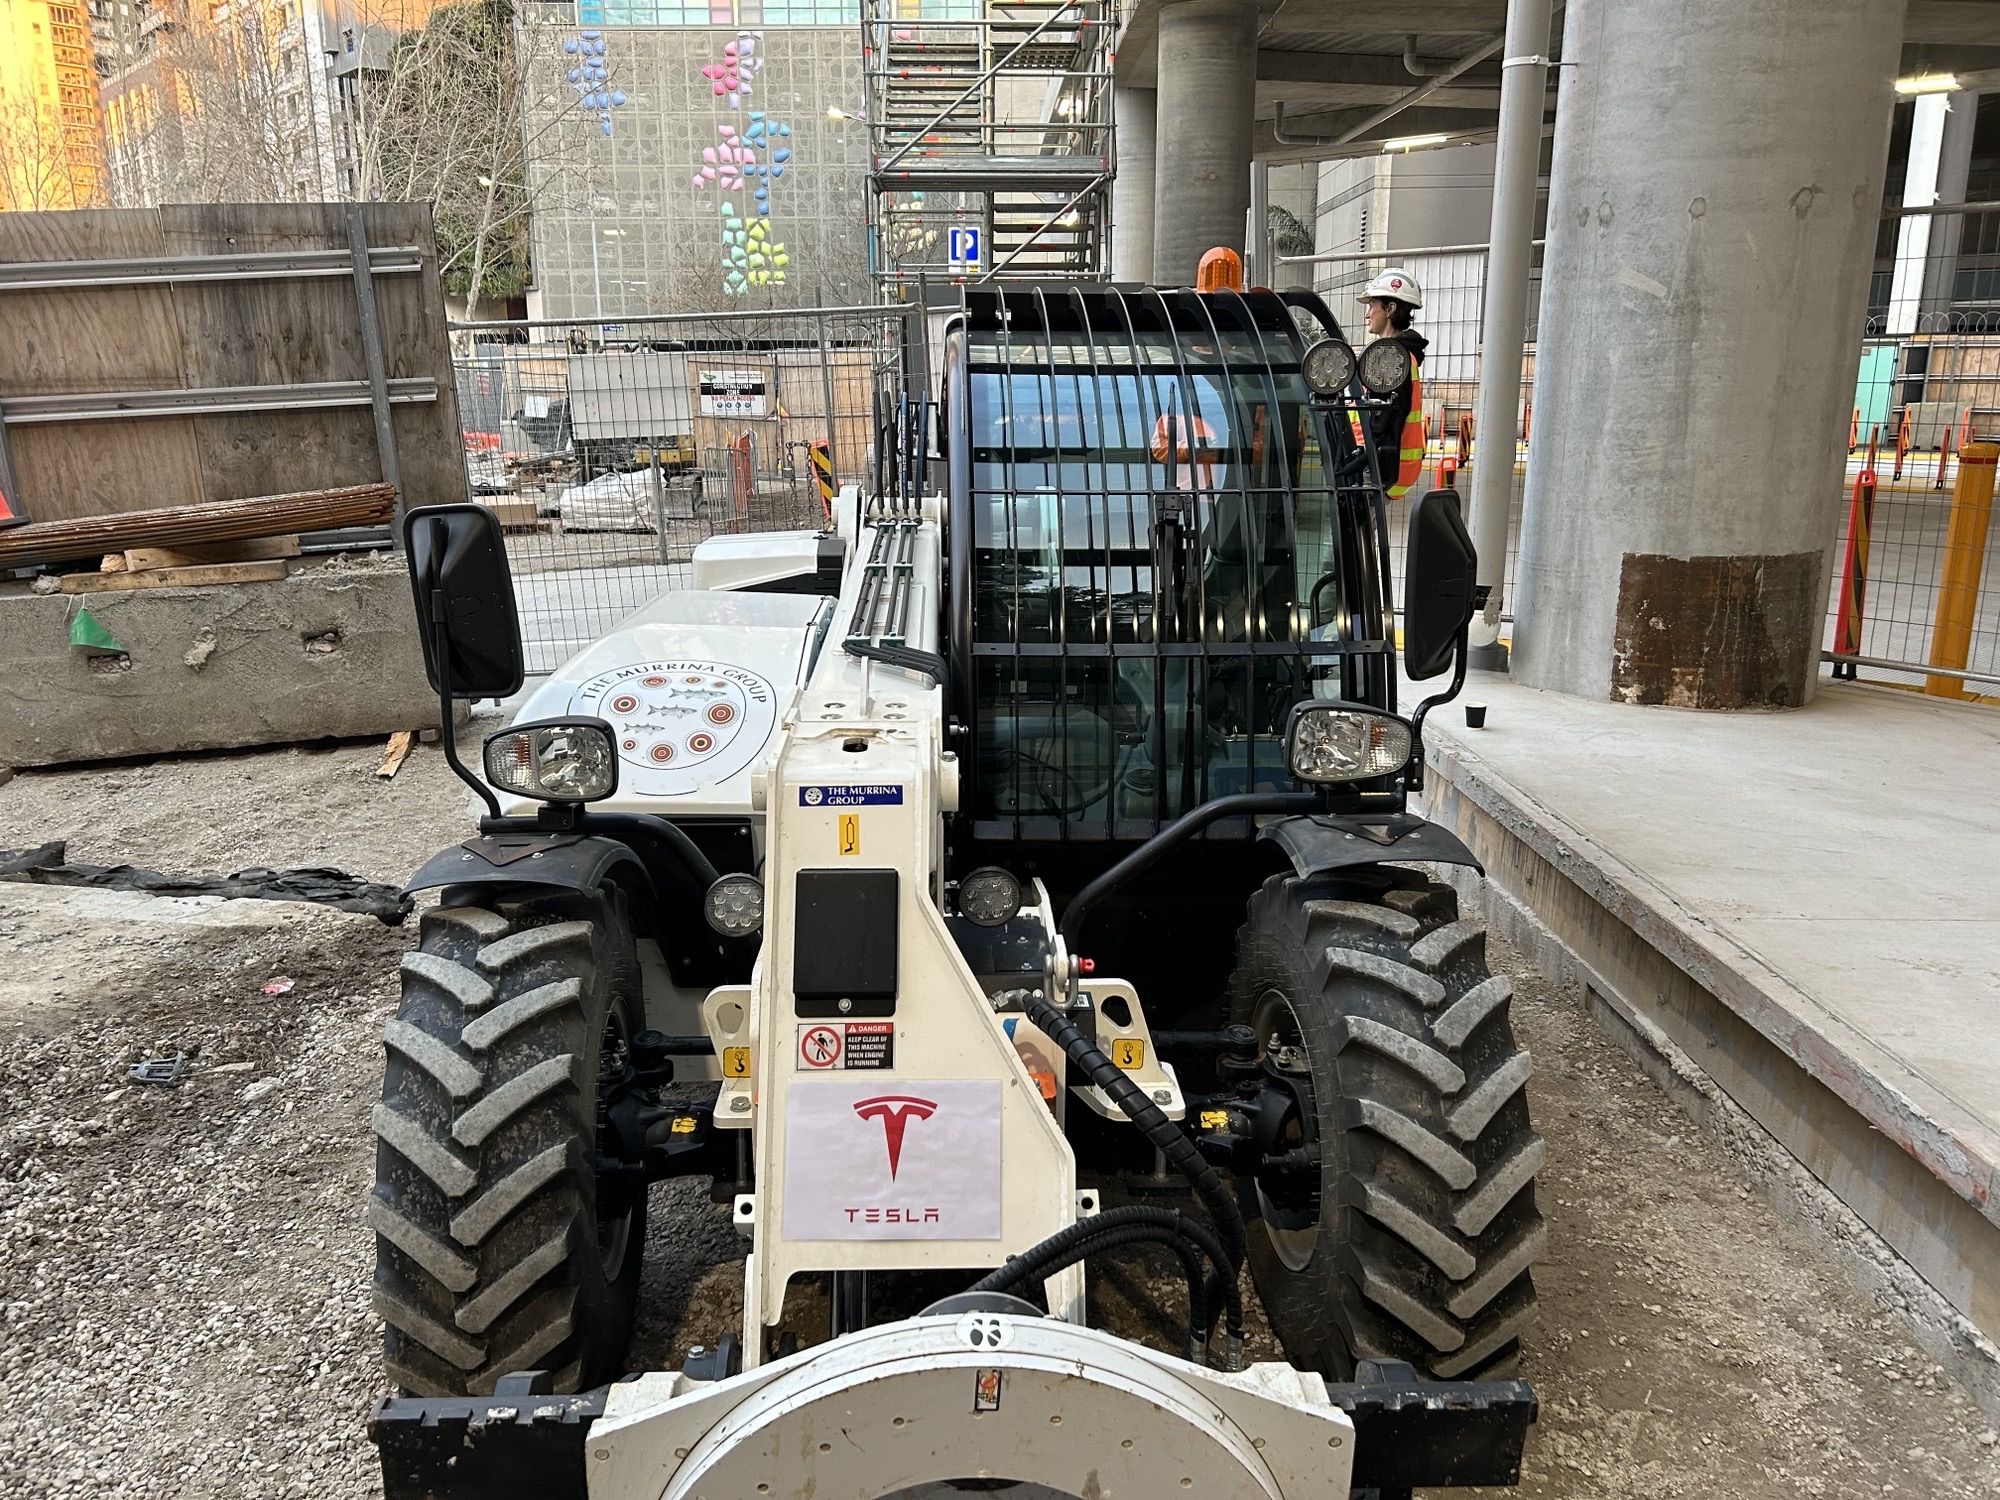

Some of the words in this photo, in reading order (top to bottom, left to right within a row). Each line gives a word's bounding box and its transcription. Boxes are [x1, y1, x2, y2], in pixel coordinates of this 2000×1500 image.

[581, 677, 613, 700] THE
[616, 662, 715, 680] MURRINA
[722, 668, 767, 703] GROUP
[827, 787, 847, 796] THE
[849, 786, 897, 795] MURRINA
[827, 796, 865, 805] GROUP
[843, 1208, 940, 1223] TESLA
